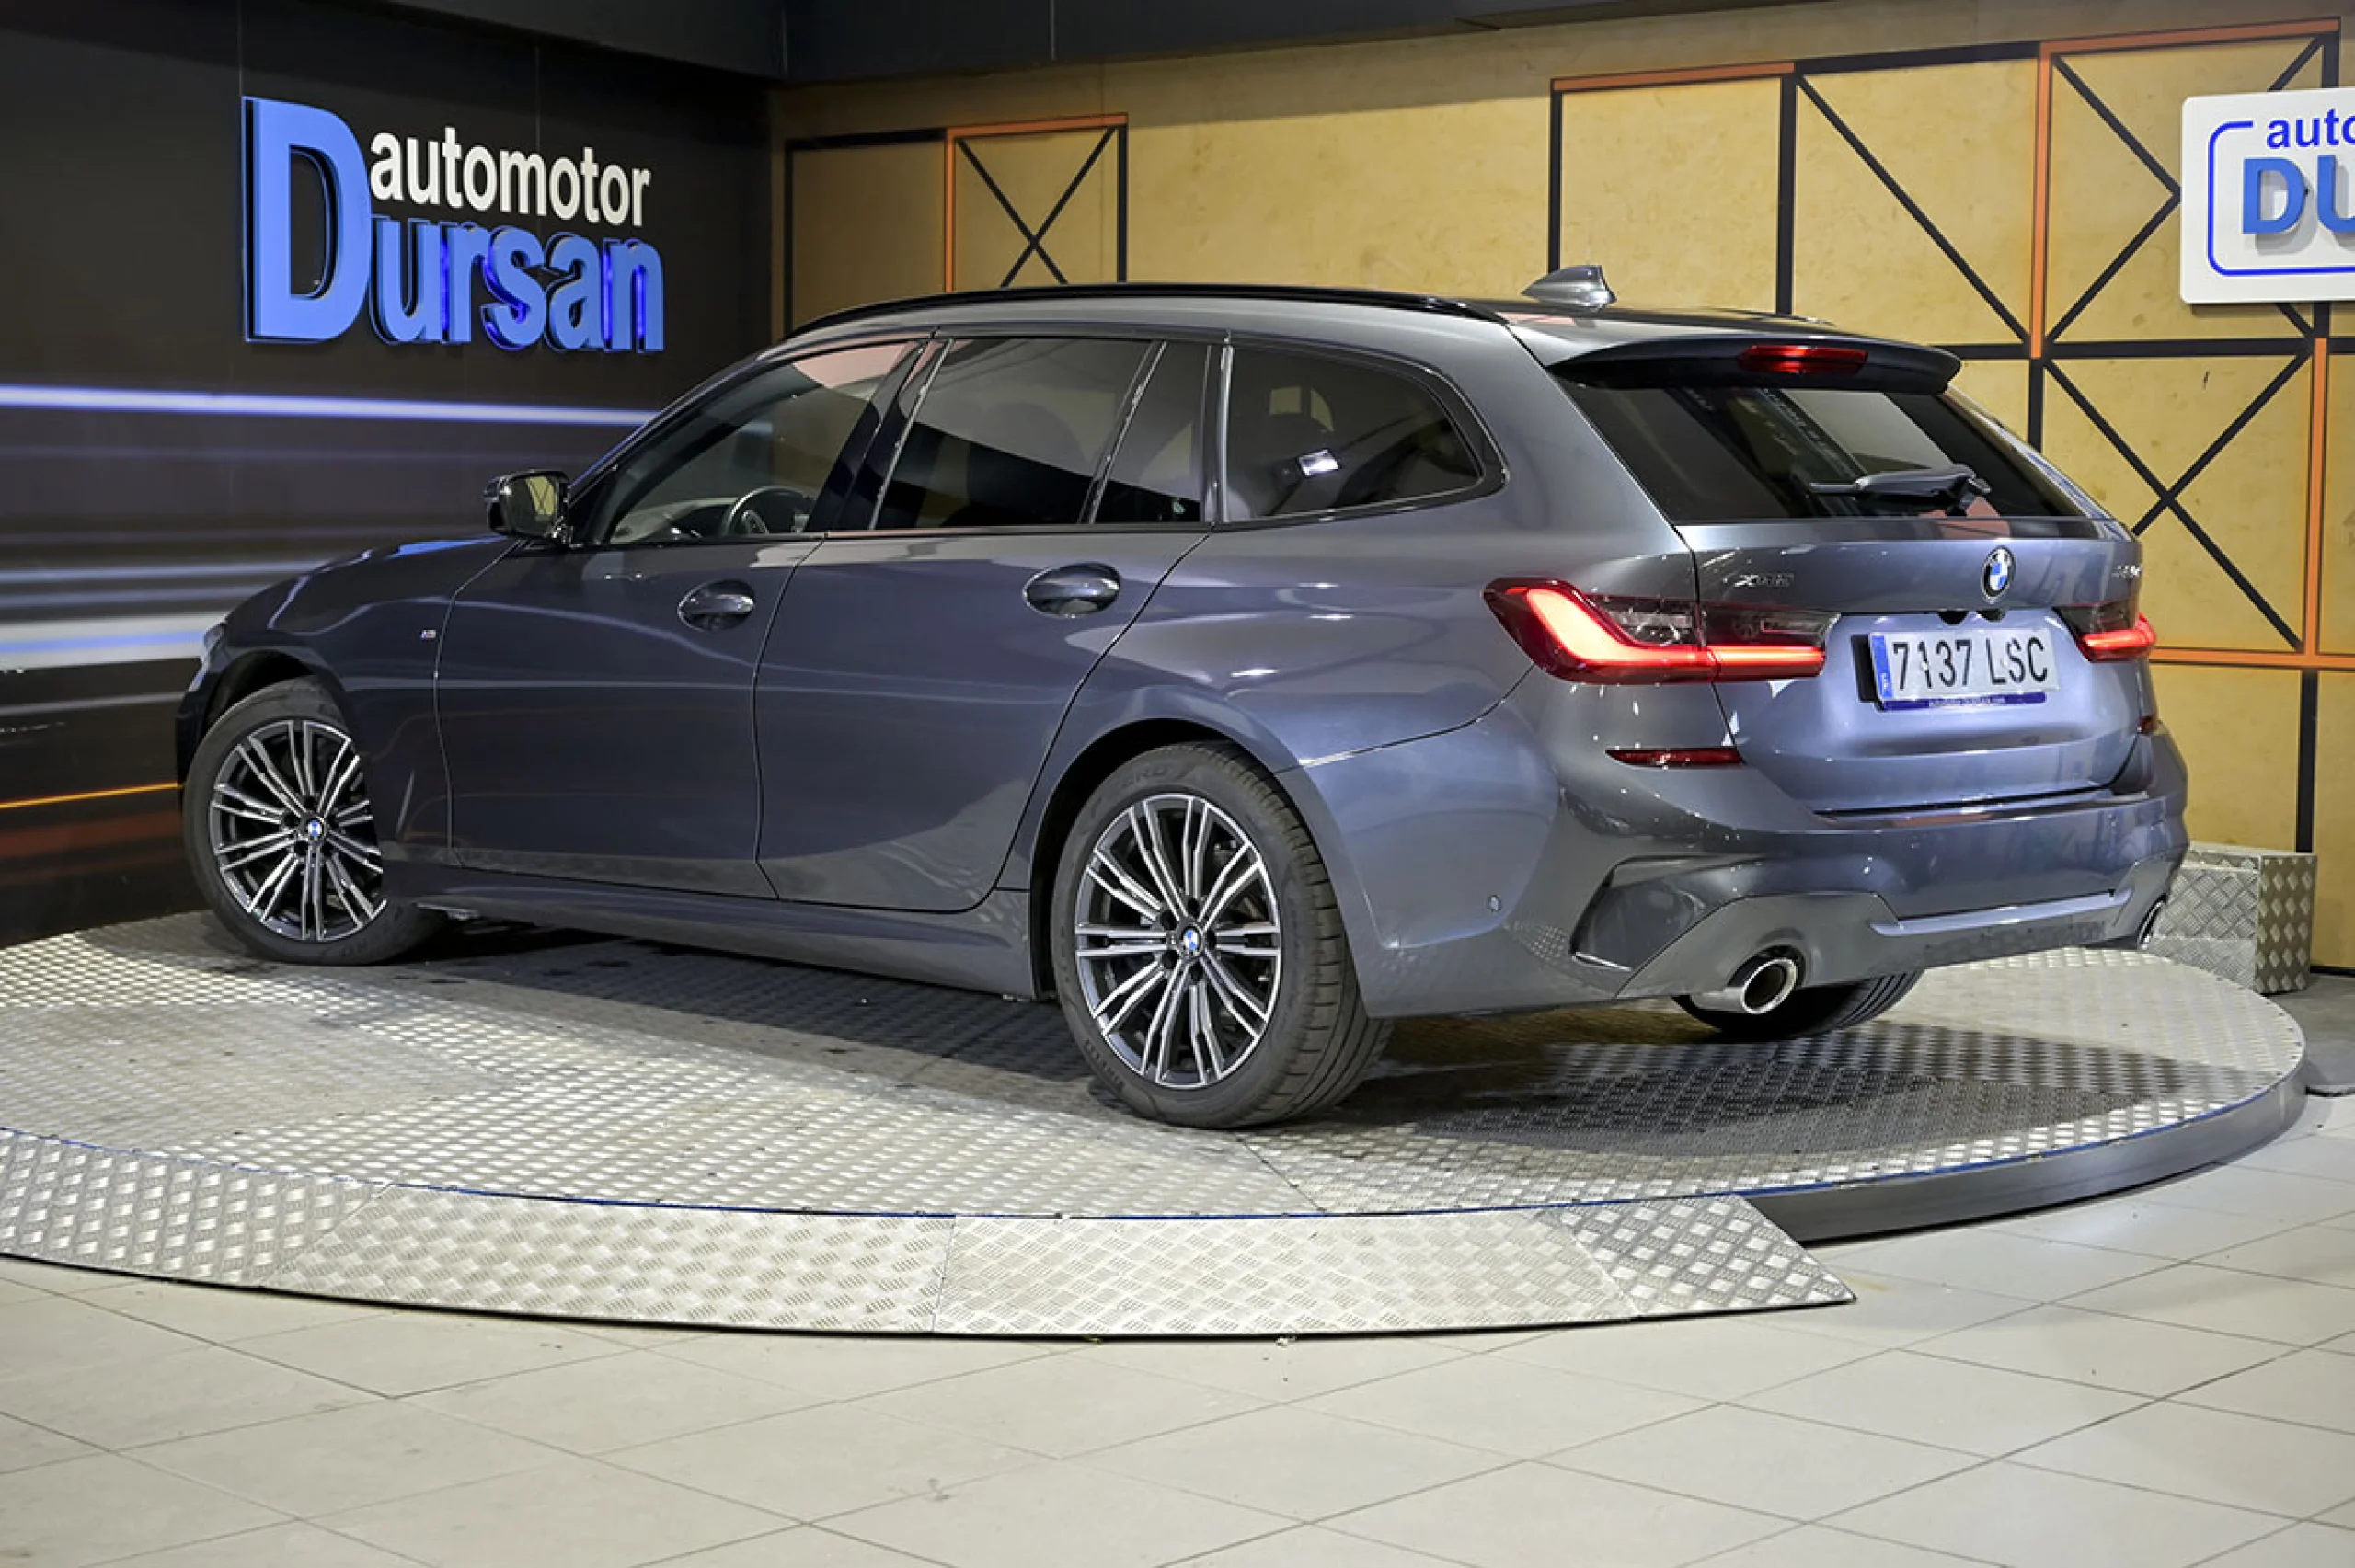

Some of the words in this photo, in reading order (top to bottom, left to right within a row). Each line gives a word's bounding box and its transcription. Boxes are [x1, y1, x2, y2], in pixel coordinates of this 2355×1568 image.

[370, 126, 651, 227] automotor
[2242, 155, 2355, 235] DU
[242, 96, 664, 353] Dursan
[1892, 639, 1972, 690] 7137
[1985, 636, 2048, 686] LSC
